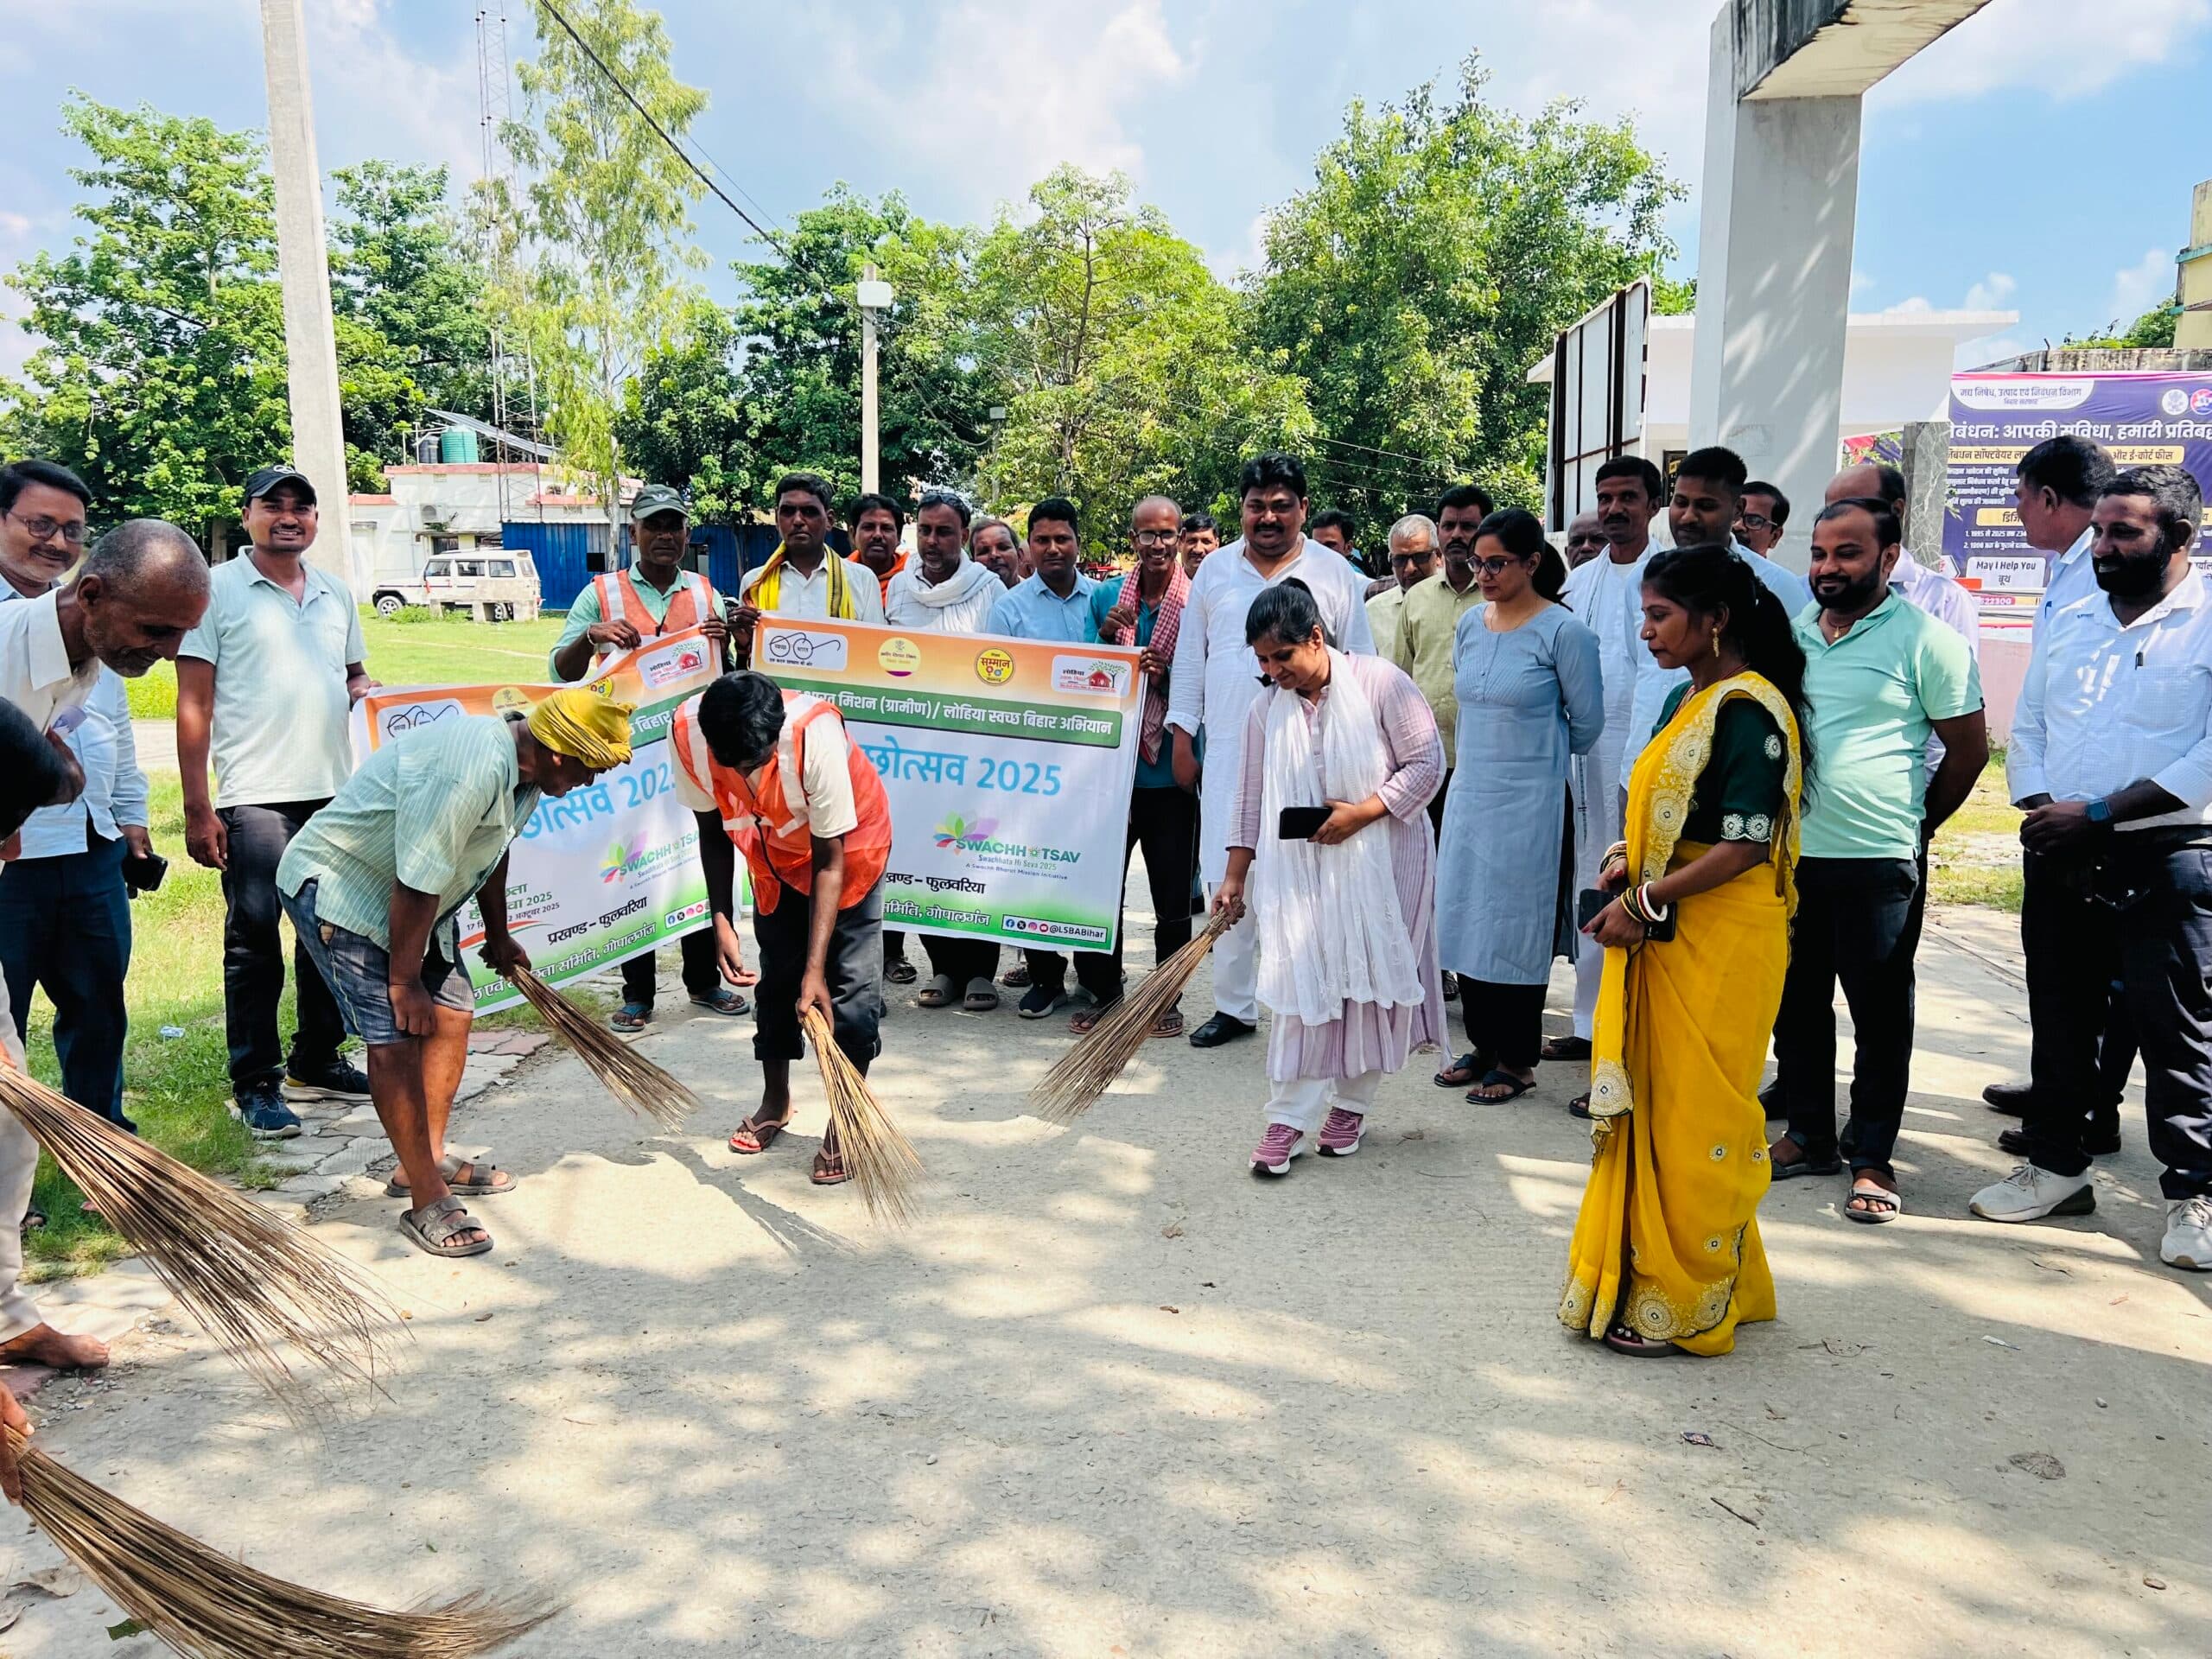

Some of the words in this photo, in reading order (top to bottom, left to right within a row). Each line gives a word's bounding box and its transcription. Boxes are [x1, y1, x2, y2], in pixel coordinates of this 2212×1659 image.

[2003, 420, 2057, 439] आपकी
[2117, 420, 2162, 441] हमारी
[1976, 561, 1993, 570] May
[2000, 561, 2018, 570] Help
[2020, 561, 2037, 570] You
[980, 657, 1011, 670] सम्मान
[635, 709, 671, 733] बिहार
[838, 690, 877, 710] मिशन
[943, 702, 987, 722] लोहिया
[988, 709, 1022, 725] स्वच्छ
[1023, 709, 1058, 728] बिहार
[1060, 715, 1114, 734] अभियान
[618, 761, 676, 809] 202
[976, 757, 1062, 797] 2025
[956, 837, 1027, 858] SWACHH
[1041, 848, 1081, 864] TSAV
[886, 872, 913, 886] खण्ड
[925, 876, 986, 894] फुलवरिया
[526, 891, 553, 906] 2025
[542, 901, 560, 913] 2025
[547, 921, 588, 945] प्रखण्ड
[599, 896, 648, 929] फुलवरिया
[925, 904, 991, 926] गोपालगंज
[603, 921, 657, 954] गोपालगंज
[1049, 925, 1104, 939] @LSBABihar
